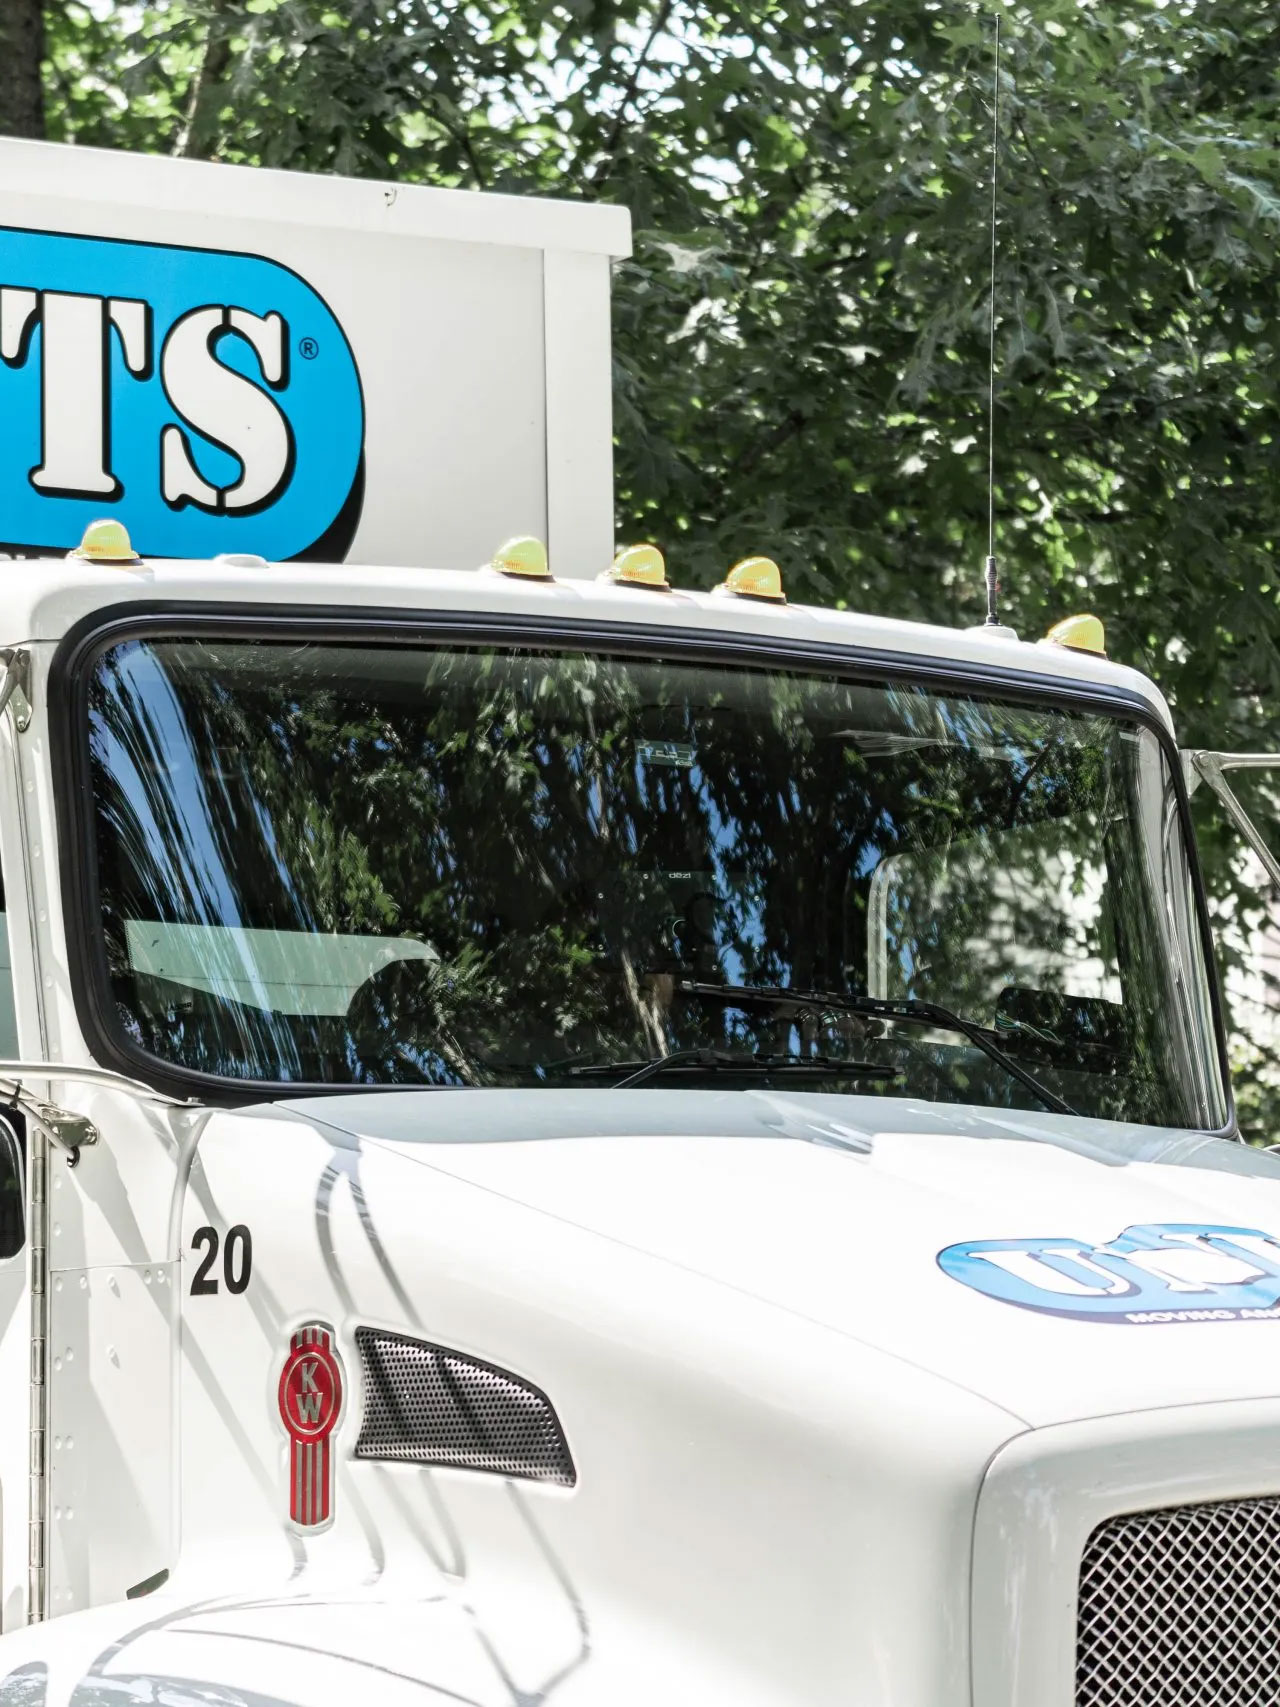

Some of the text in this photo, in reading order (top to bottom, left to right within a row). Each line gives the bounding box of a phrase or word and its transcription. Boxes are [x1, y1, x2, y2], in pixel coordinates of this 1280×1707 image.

[190, 1224, 252, 1296] 20
[301, 1362, 319, 1393] K
[295, 1392, 324, 1424] W
